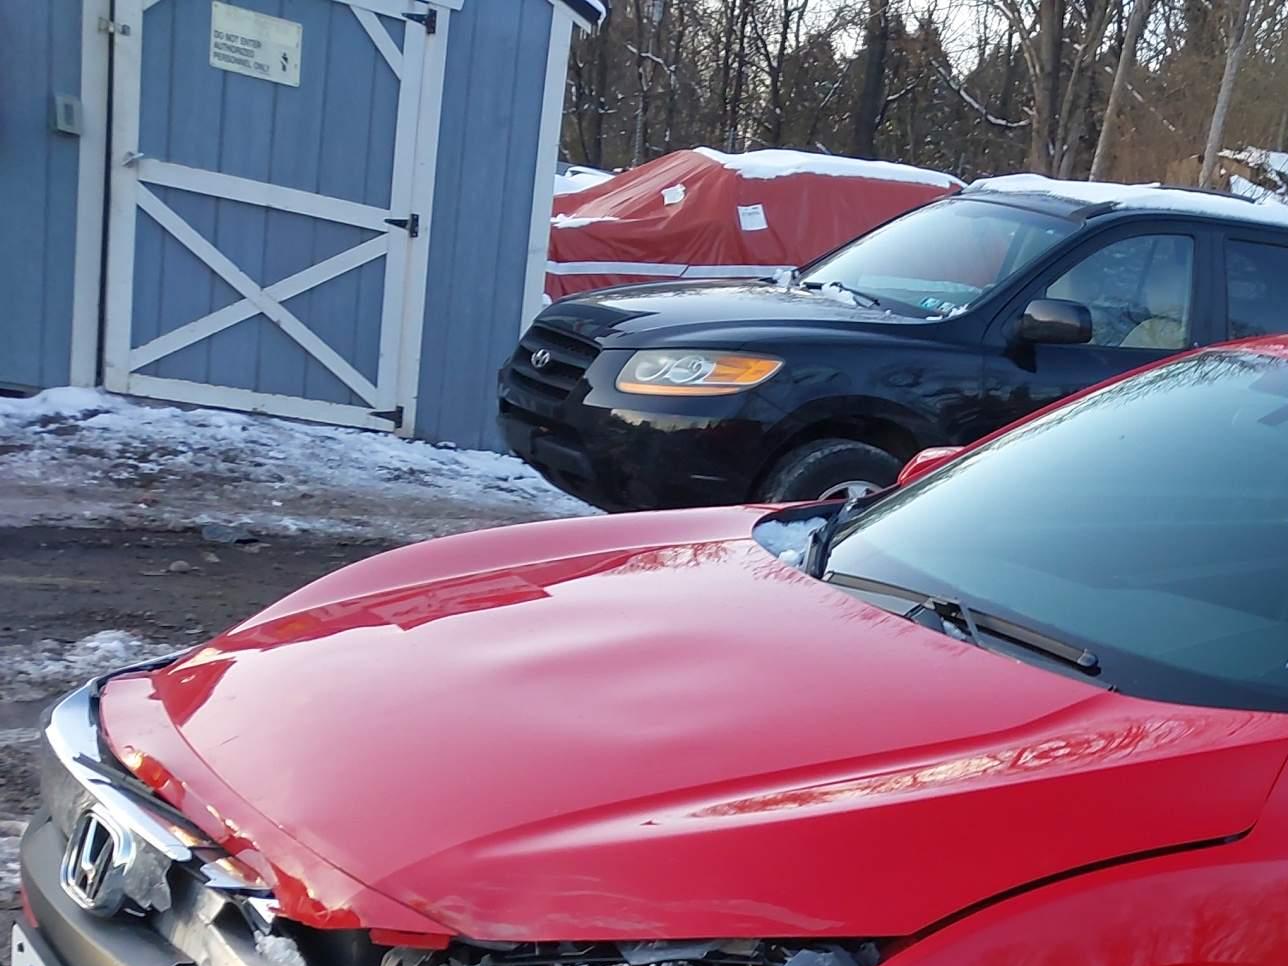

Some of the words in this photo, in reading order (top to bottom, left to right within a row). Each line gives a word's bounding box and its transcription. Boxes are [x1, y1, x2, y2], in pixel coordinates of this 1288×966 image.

[214, 30, 224, 40] DO
[225, 32, 240, 43] NOT
[240, 36, 262, 48] ENTER
[214, 41, 255, 58] AUTHORIZED
[213, 51, 252, 68] PERSONNEL
[253, 61, 270, 72] ONLY
